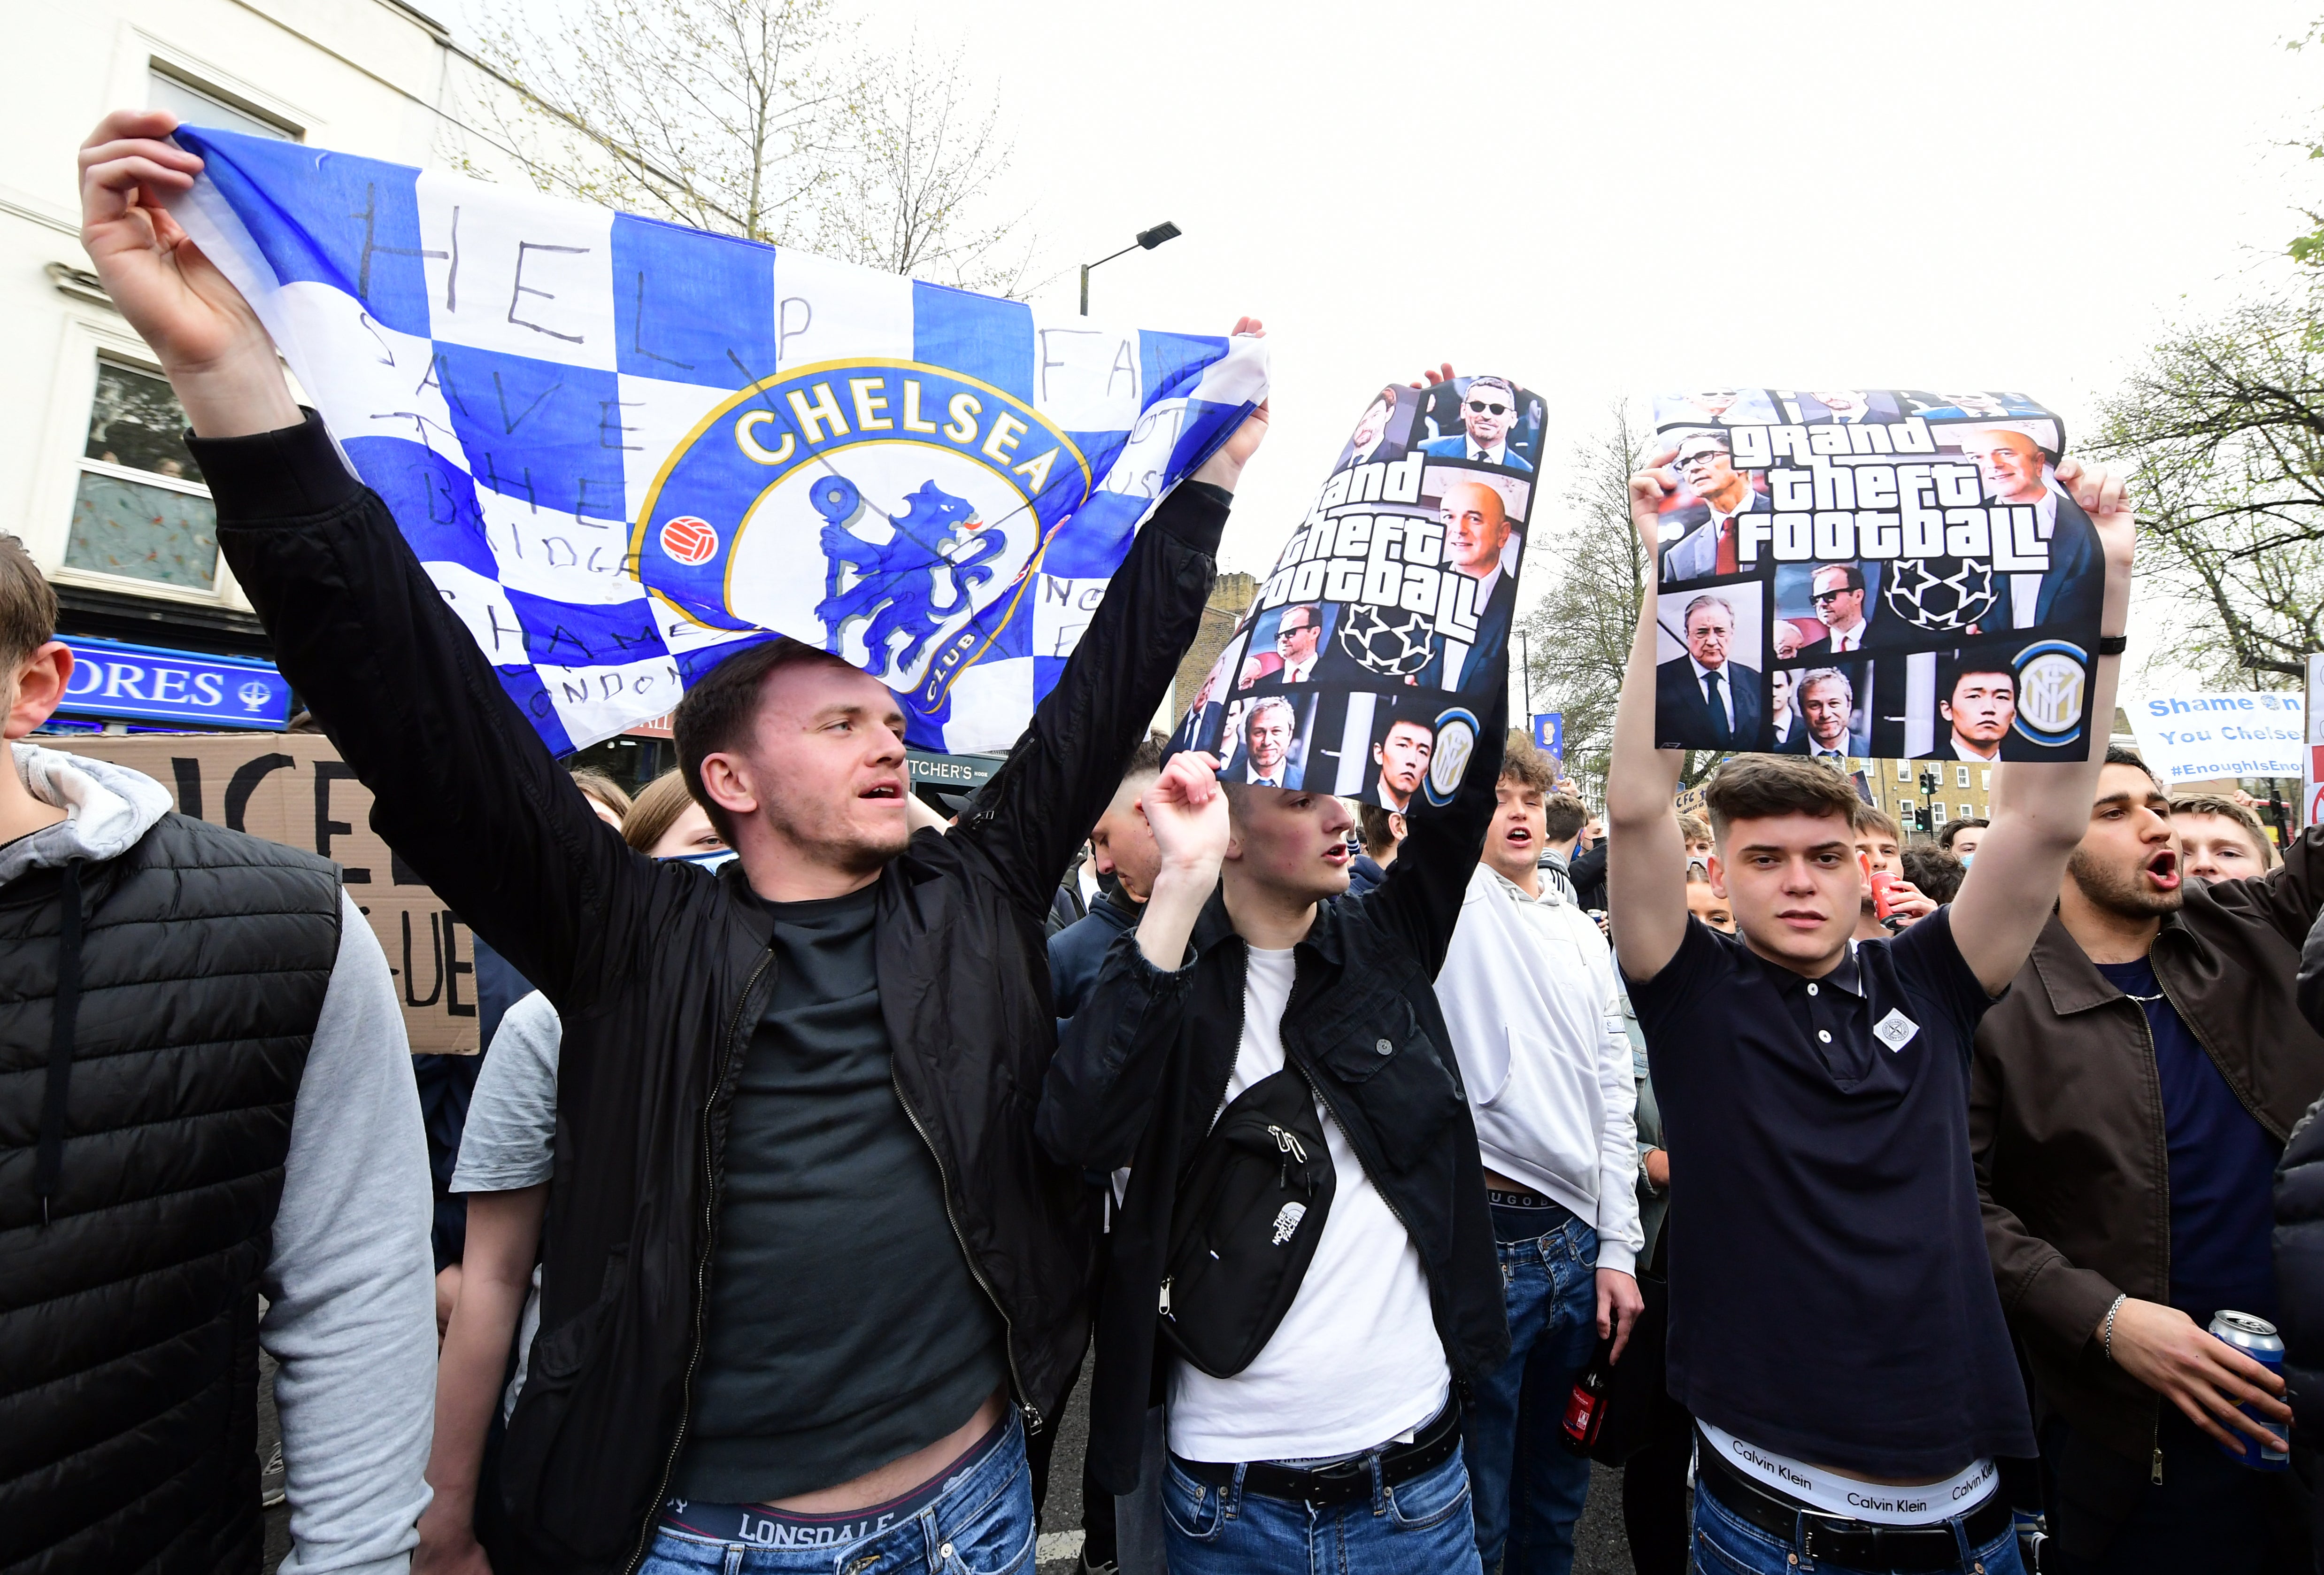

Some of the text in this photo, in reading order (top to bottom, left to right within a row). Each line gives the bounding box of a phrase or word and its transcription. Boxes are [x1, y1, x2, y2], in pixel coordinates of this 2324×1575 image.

[348, 182, 812, 370] HELP
[359, 312, 647, 451] SAVE
[734, 377, 1062, 495] CHELSEA
[438, 589, 702, 658] HAME
[66, 658, 223, 706] ORES
[927, 633, 976, 702] CLUB
[2148, 698, 2254, 717] Shame
[2159, 731, 2212, 745] You
[2221, 726, 2304, 740] Chelse
[1272, 1215, 1292, 1246] NORTH
[1273, 1211, 1286, 1228] THE
[1283, 1219, 1299, 1242] FACE
[1732, 1440, 1812, 1491] Calvin Klein
[1952, 1459, 1994, 1500] Calvin Kle
[1847, 1492, 1928, 1513] Calvin Klein
[739, 1512, 894, 1545] LONSDALE
